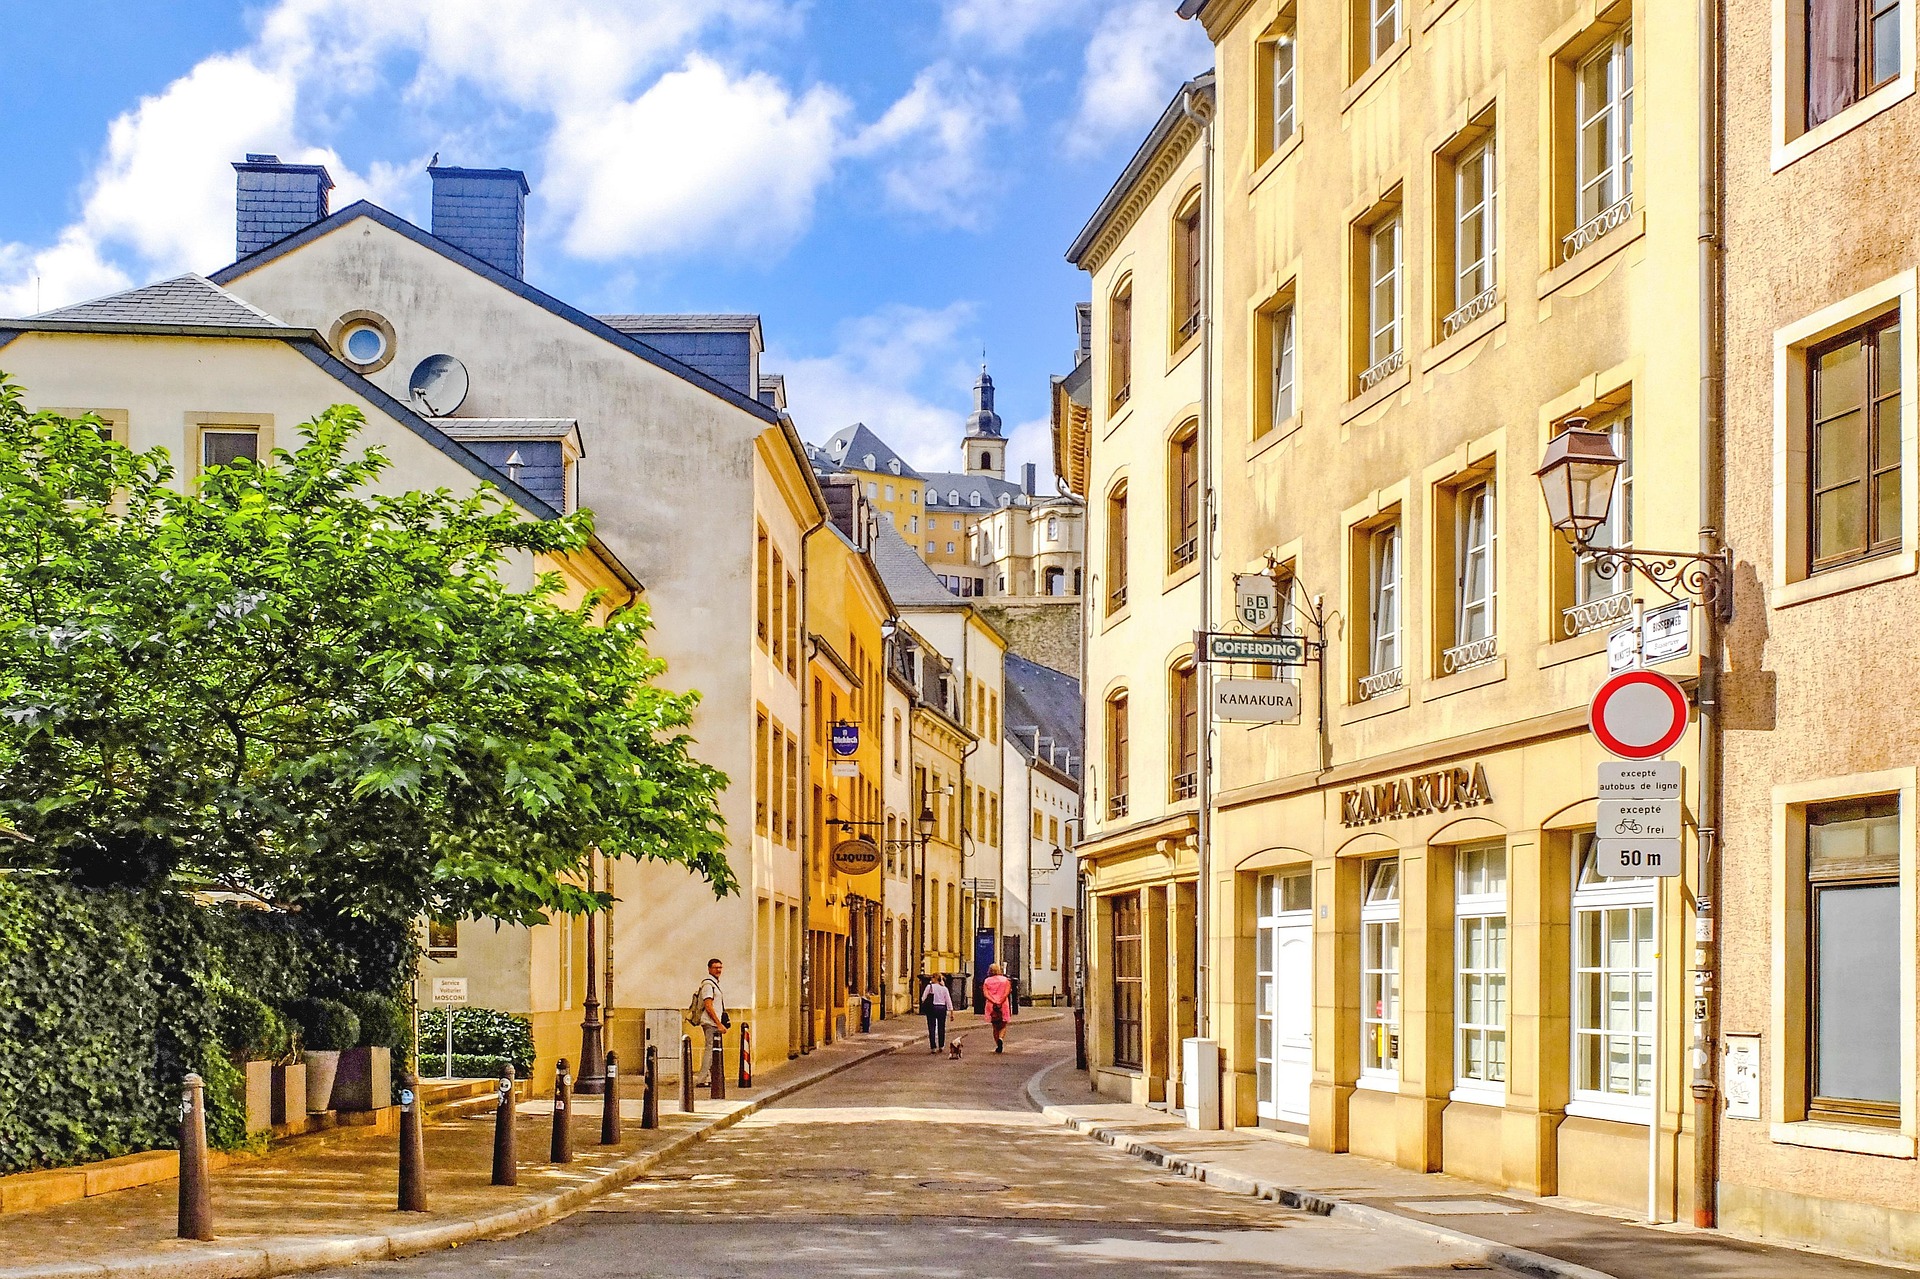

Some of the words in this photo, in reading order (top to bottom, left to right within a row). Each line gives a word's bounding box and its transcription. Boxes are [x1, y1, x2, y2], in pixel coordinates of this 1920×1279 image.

[1247, 596, 1254, 606] B
[1259, 597, 1266, 607] B
[1247, 610, 1255, 619] B
[1259, 610, 1266, 619] B
[1215, 641, 1297, 656] BOFFERDING
[1220, 693, 1293, 707] KAMAKURA
[1621, 769, 1657, 778] excepté
[1640, 782, 1651, 790] de
[1656, 782, 1678, 791] ligne
[1340, 762, 1493, 828] KAMAKURA
[1620, 805, 1661, 815] excepté
[1647, 826, 1664, 834] frei
[836, 853, 875, 862] LIQUID
[1620, 850, 1641, 866] 50
[1647, 853, 1661, 866] m
